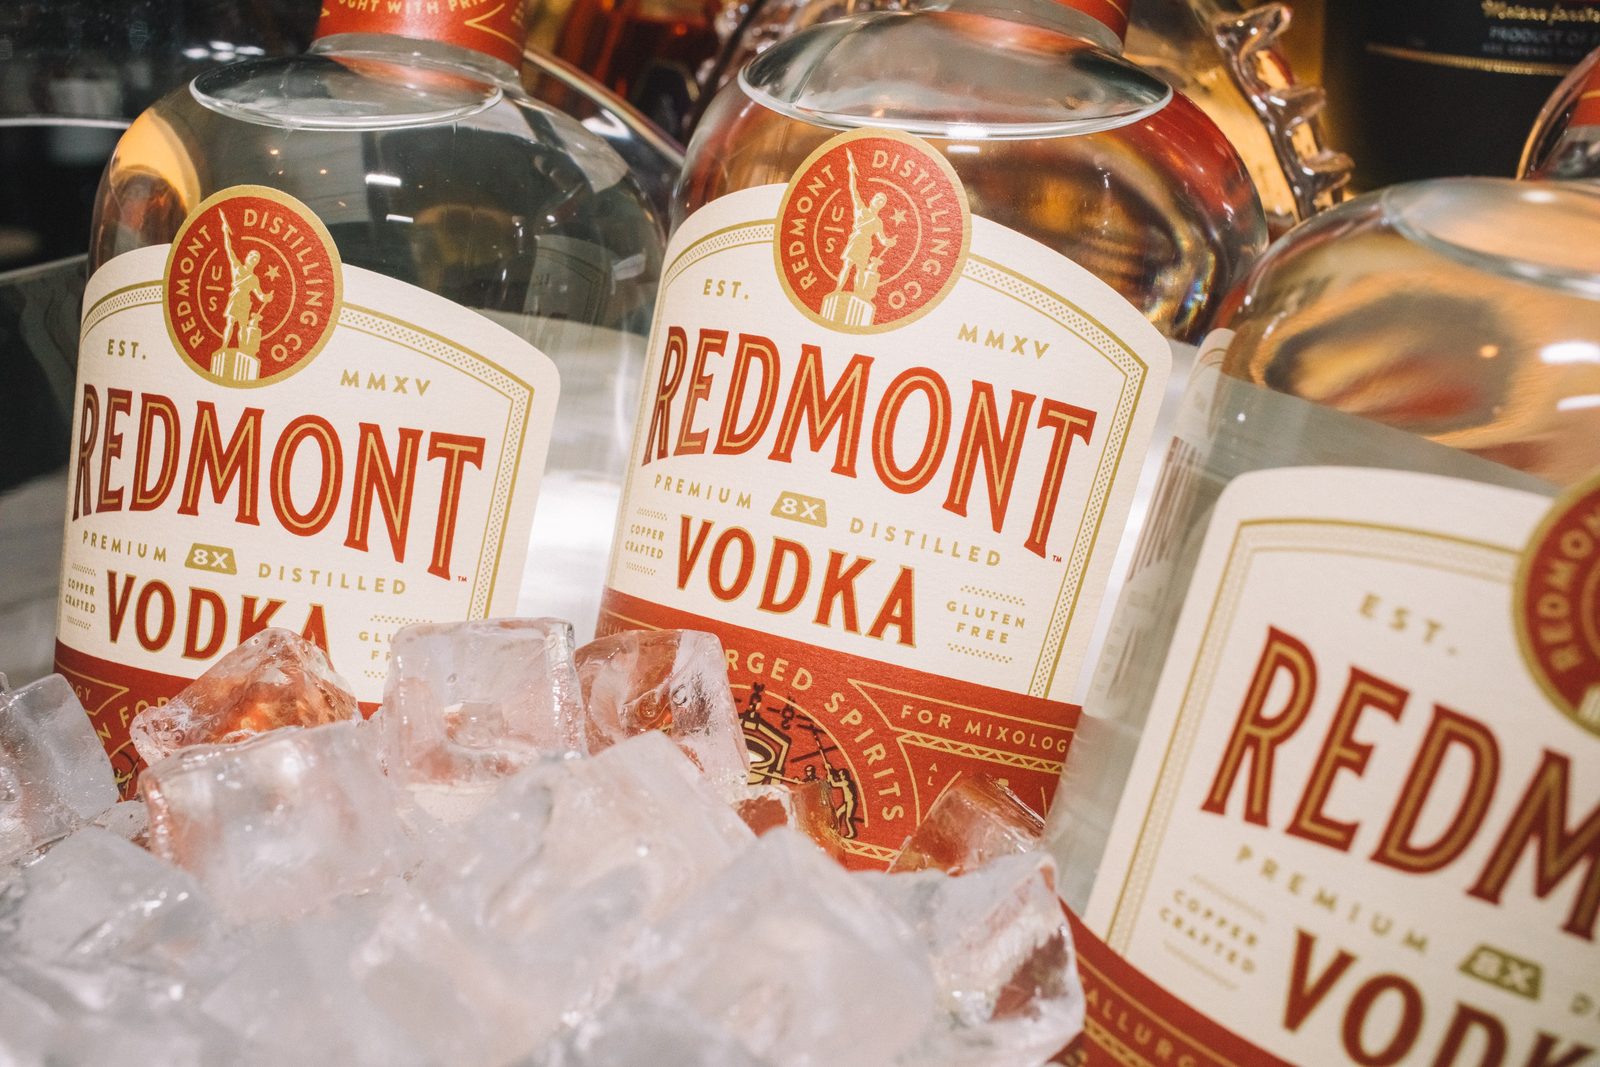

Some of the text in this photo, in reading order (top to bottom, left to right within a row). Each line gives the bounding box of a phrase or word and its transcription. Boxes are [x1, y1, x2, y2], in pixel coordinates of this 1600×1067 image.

[339, 0, 378, 12] GHT
[387, 0, 439, 14] WITH
[789, 149, 951, 310] REDMONT DISTILLING CO
[175, 208, 323, 362] REDMONT DISTILLING CO
[703, 279, 750, 300] EST.
[107, 339, 147, 360] EST.
[957, 322, 1051, 360] MMXV
[340, 369, 431, 396] MMXV
[641, 325, 1098, 560] REDMONT
[72, 383, 486, 581] REDMONT
[630, 523, 664, 542] COPPER
[654, 473, 1001, 568] PREMIUM 8X DISTILLED
[82, 530, 406, 595] PREMIUM 8X DISTILLED
[624, 540, 663, 560] CRAFTED
[65, 594, 96, 614] CRAFTED
[67, 578, 95, 596] COPPER
[676, 513, 917, 649] VODKA
[946, 600, 1025, 629] GLUTEN
[956, 622, 1009, 644] FREE
[1359, 591, 1459, 656] EST.
[901, 704, 1068, 753] FOR MIXOLOG
[824, 691, 904, 822] SPIRITS
[1172, 888, 1258, 949] COPPER
[1236, 843, 1430, 957] PREMIUM
[1159, 906, 1257, 975] CRAFTED
